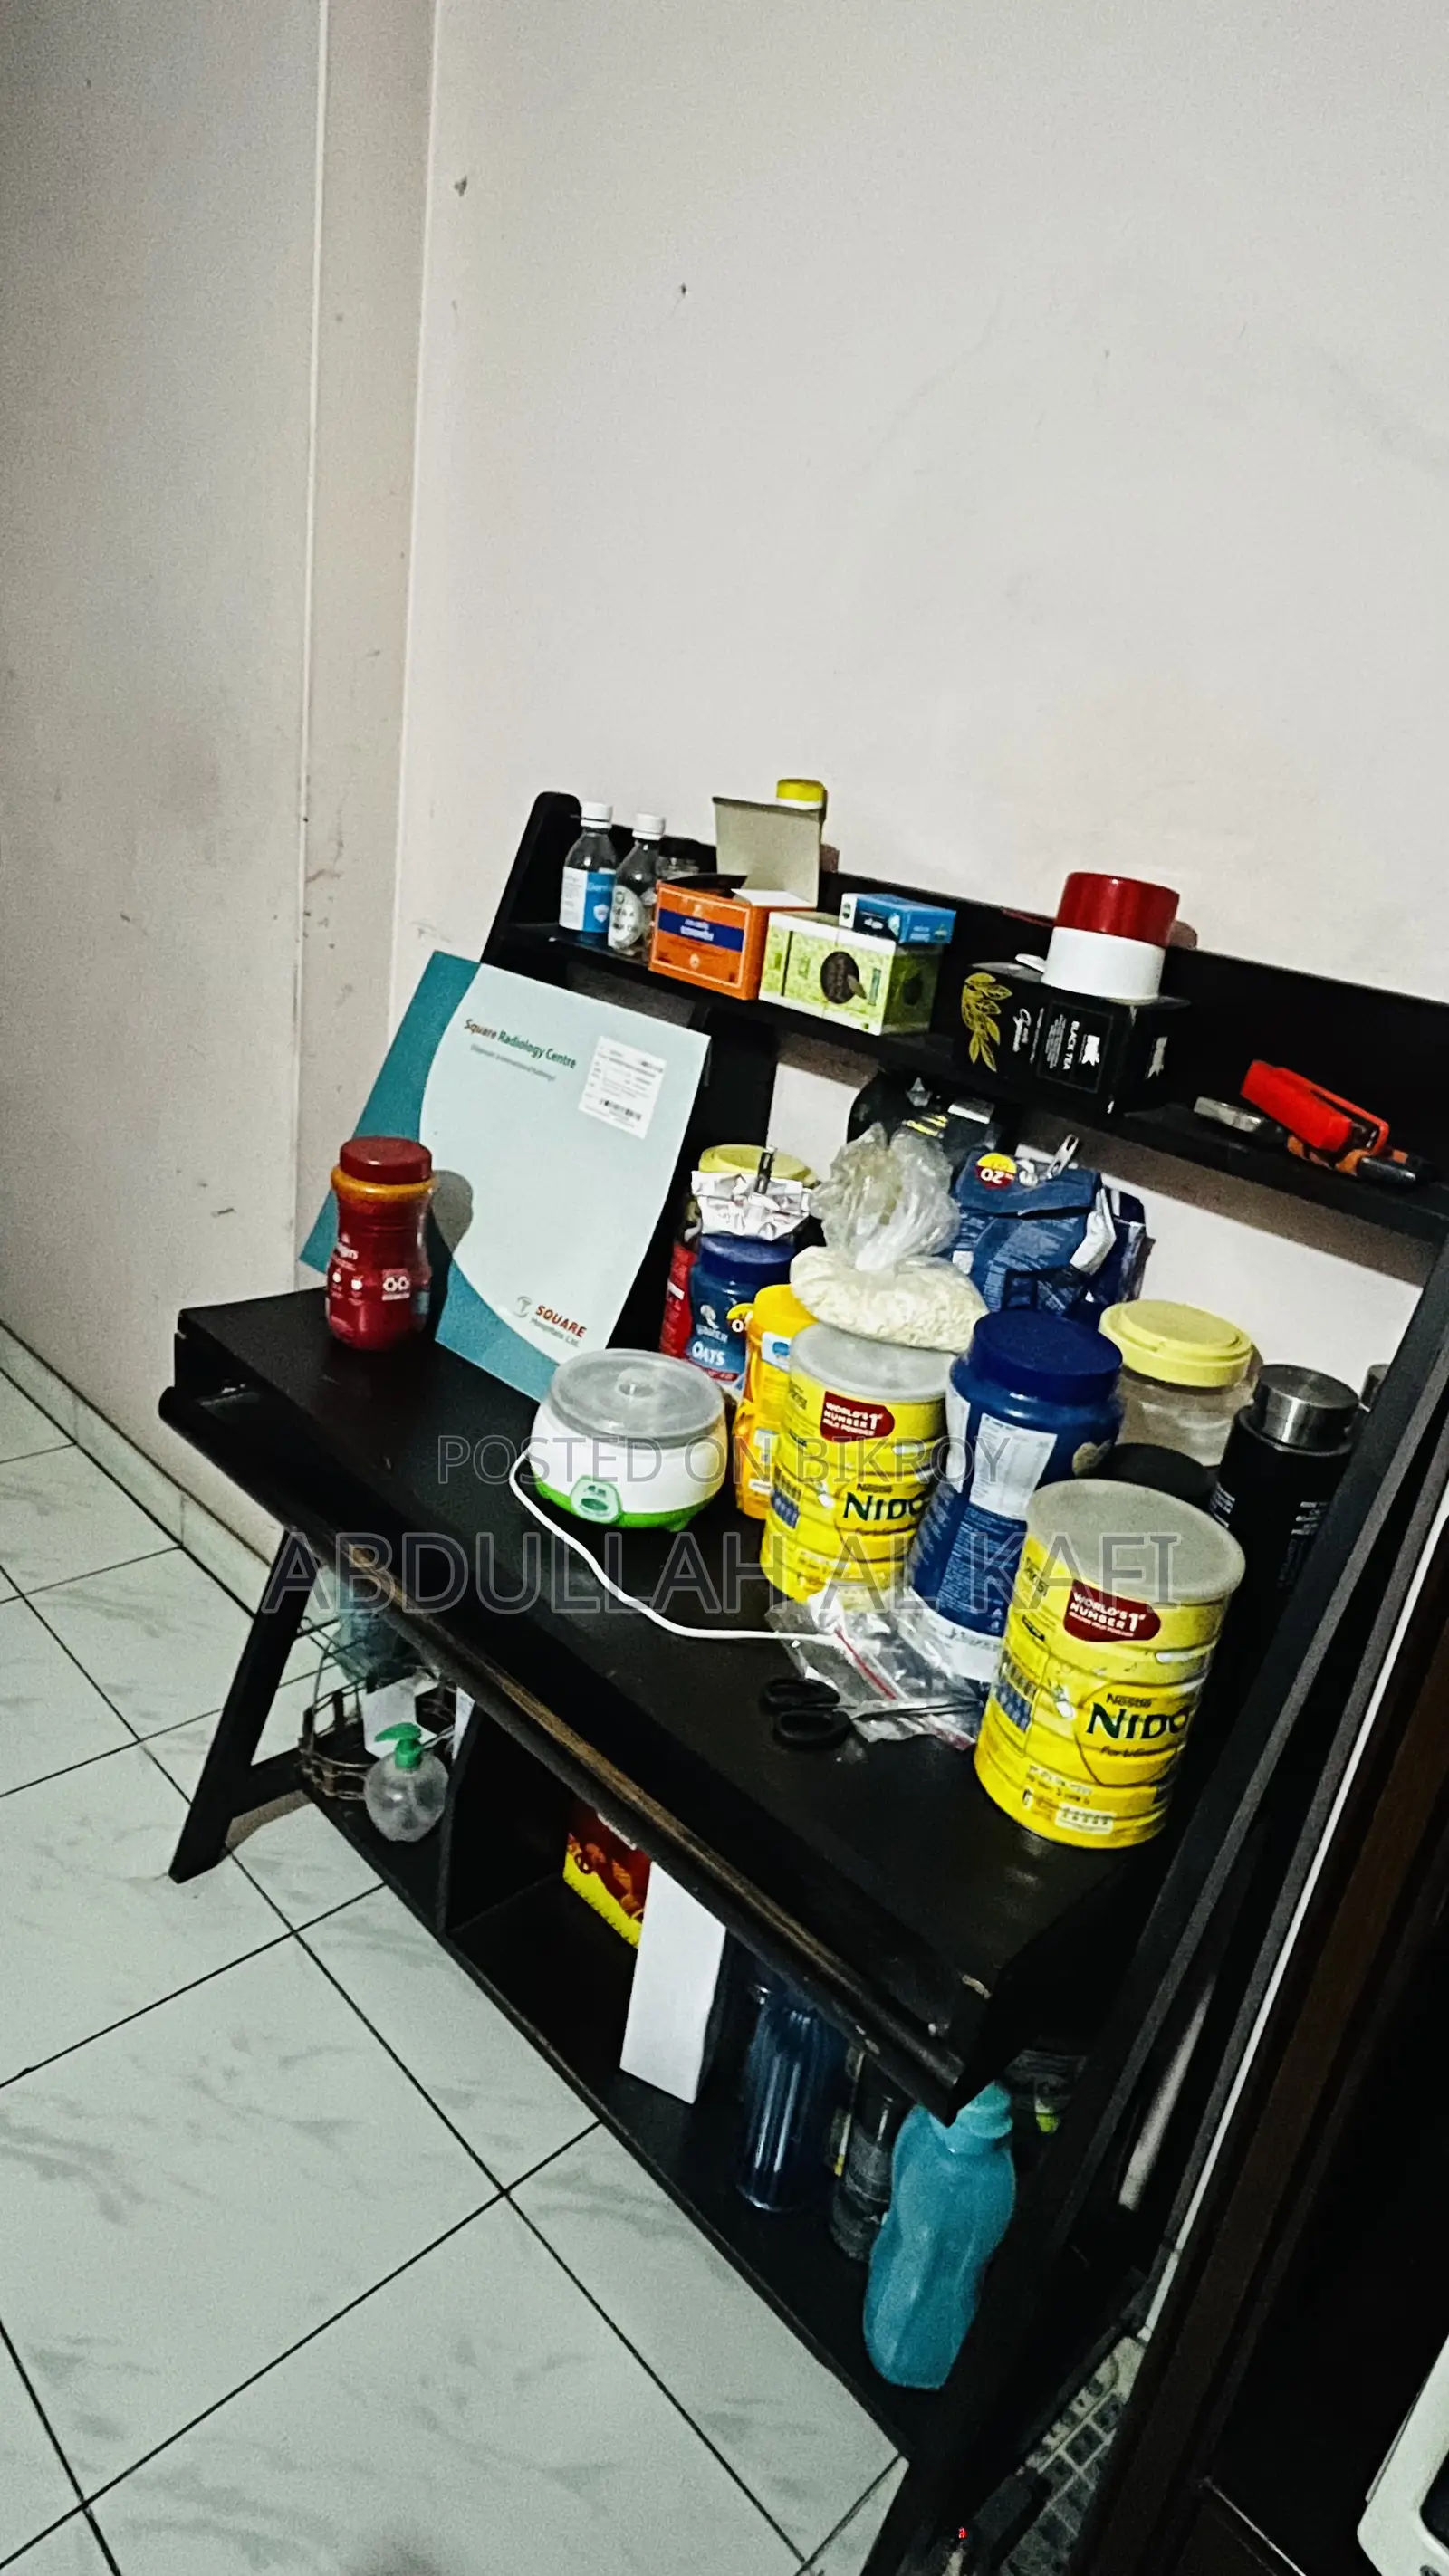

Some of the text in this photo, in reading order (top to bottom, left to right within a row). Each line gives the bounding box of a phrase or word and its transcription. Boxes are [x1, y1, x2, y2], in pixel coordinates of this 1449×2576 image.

[464, 1018, 497, 1040] Square
[498, 1030, 545, 1059] Radiology
[545, 1048, 577, 1070] Centre
[1062, 1020, 1080, 1070] BLACK TEA
[535, 1304, 587, 1338] SQUARE
[692, 1340, 725, 1366] OATS
[824, 1410, 868, 1429] NUMBER
[826, 1402, 868, 1421] WORLD'S
[1070, 1602, 1126, 1630] NUMBER
[1072, 1592, 1128, 1621] WORLD'S
[1086, 1701, 1191, 1740] NIDO
